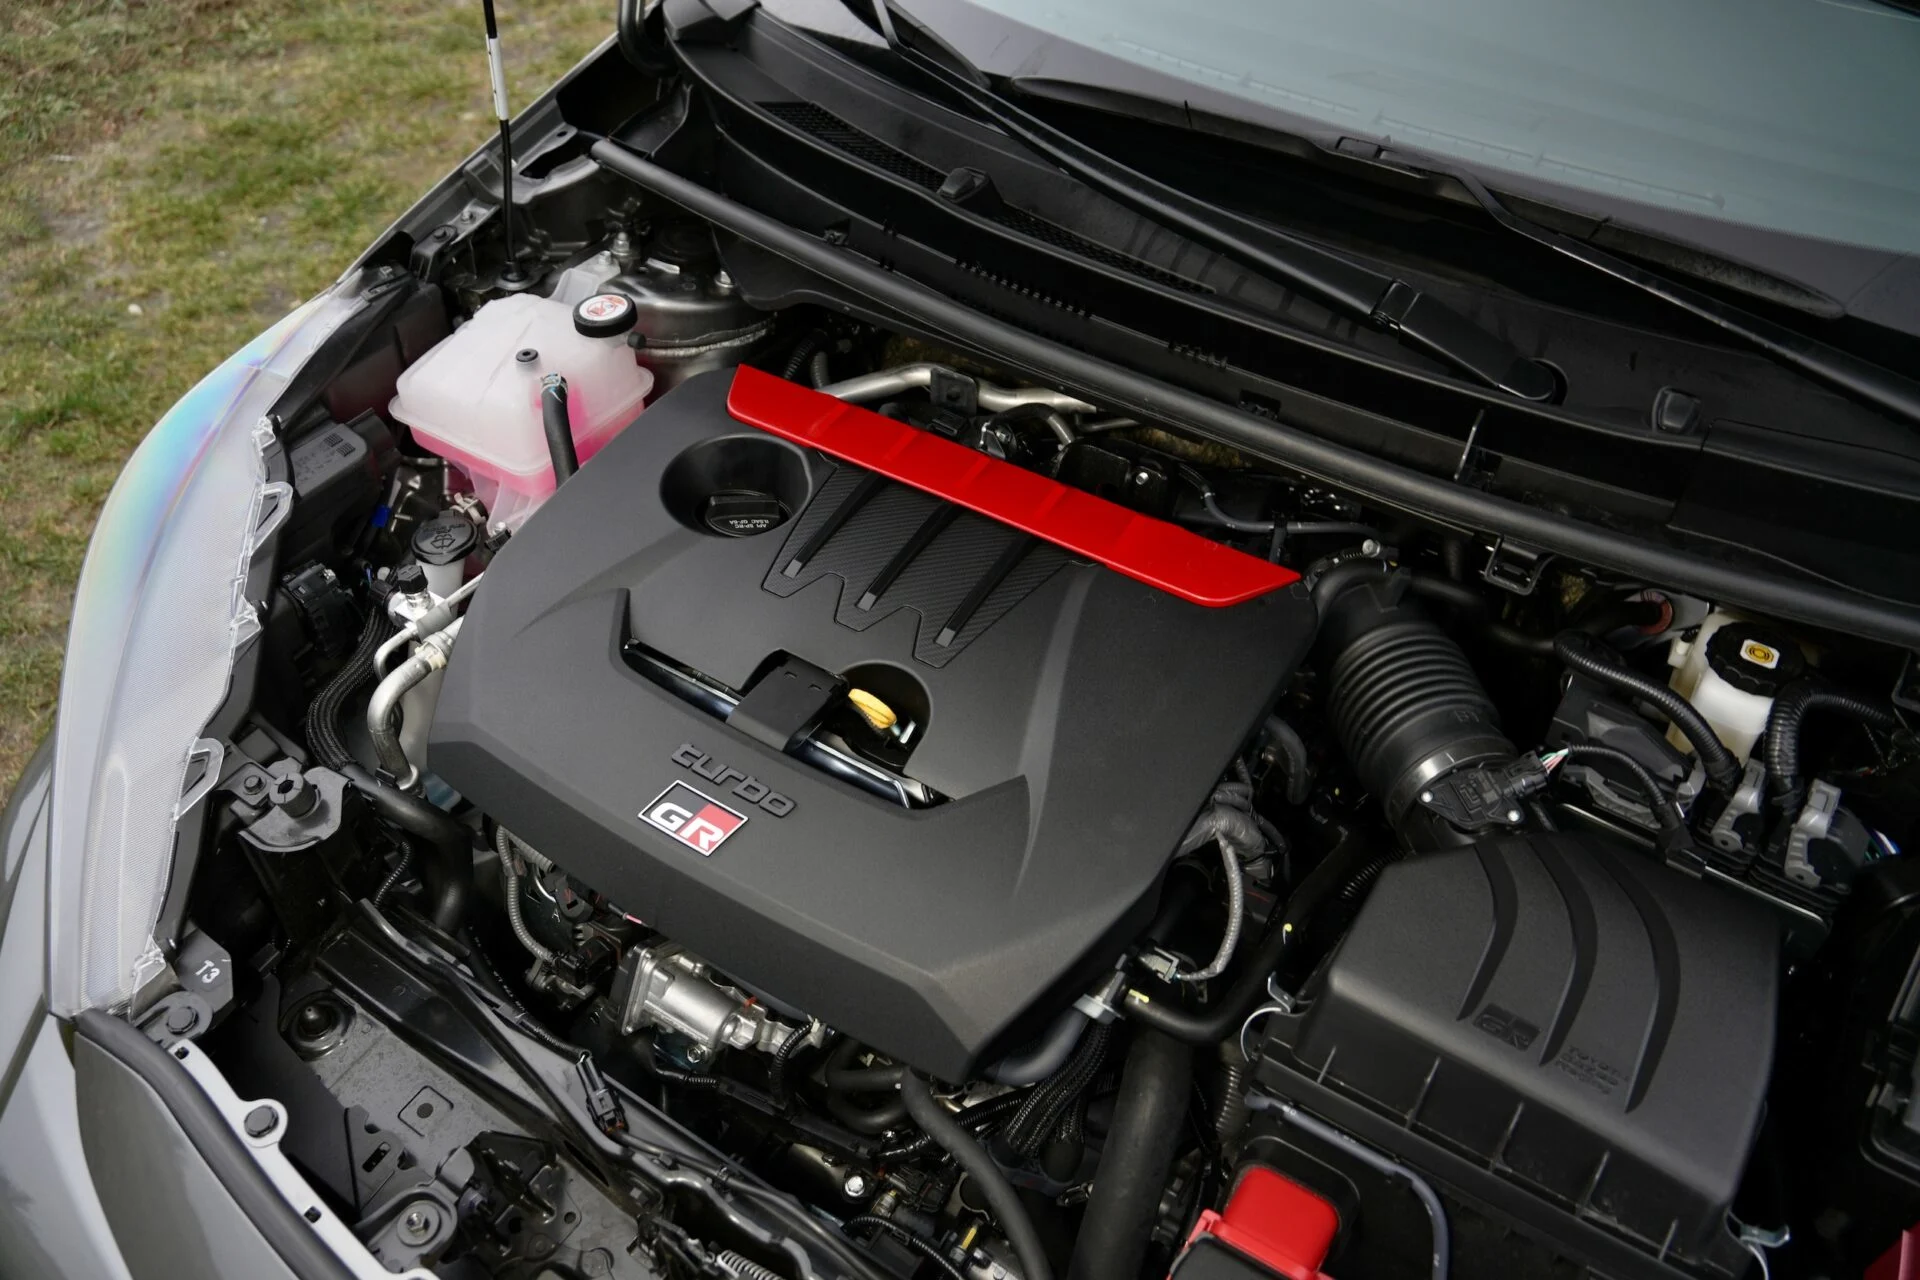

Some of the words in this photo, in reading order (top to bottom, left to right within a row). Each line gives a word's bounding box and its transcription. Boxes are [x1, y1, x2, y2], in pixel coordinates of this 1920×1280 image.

[671, 743, 797, 818] turbo
[650, 802, 724, 850] GR
[195, 959, 221, 984] T3
[1481, 1013, 1530, 1048] GR
